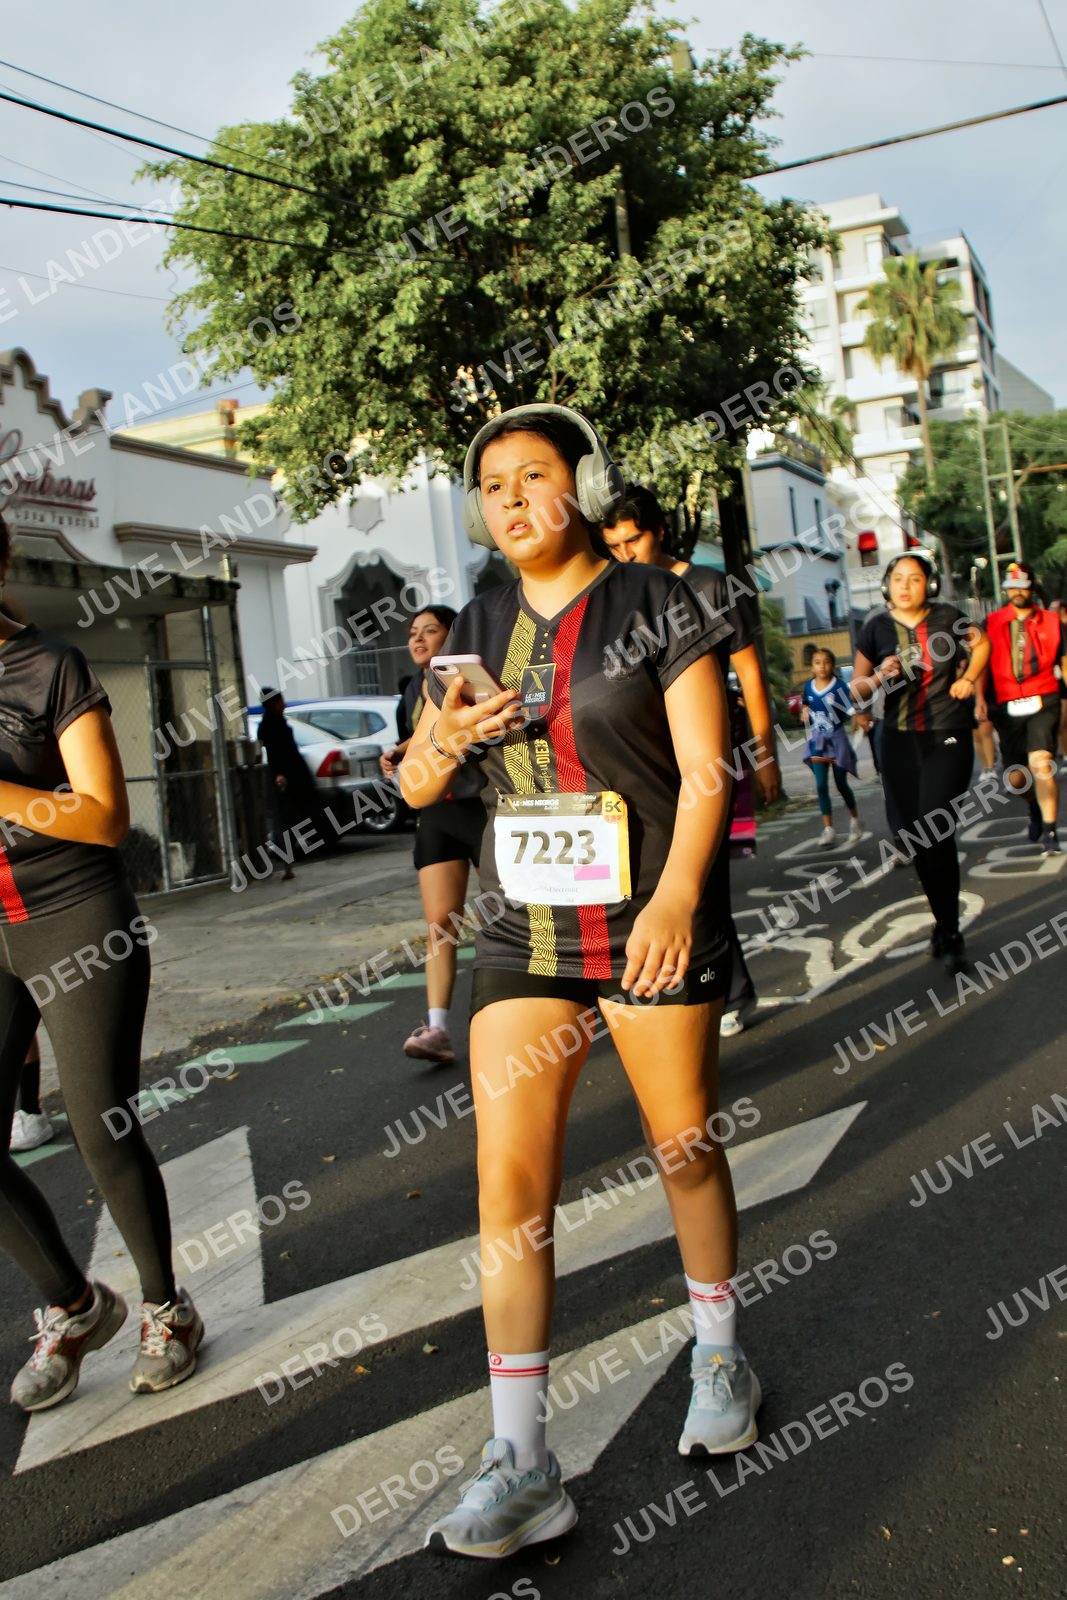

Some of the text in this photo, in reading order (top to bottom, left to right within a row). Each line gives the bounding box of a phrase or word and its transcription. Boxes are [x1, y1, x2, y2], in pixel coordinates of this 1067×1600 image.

[605, 800, 622, 813] 5K
[510, 829, 597, 865] 7223
[700, 967, 716, 983] alo
